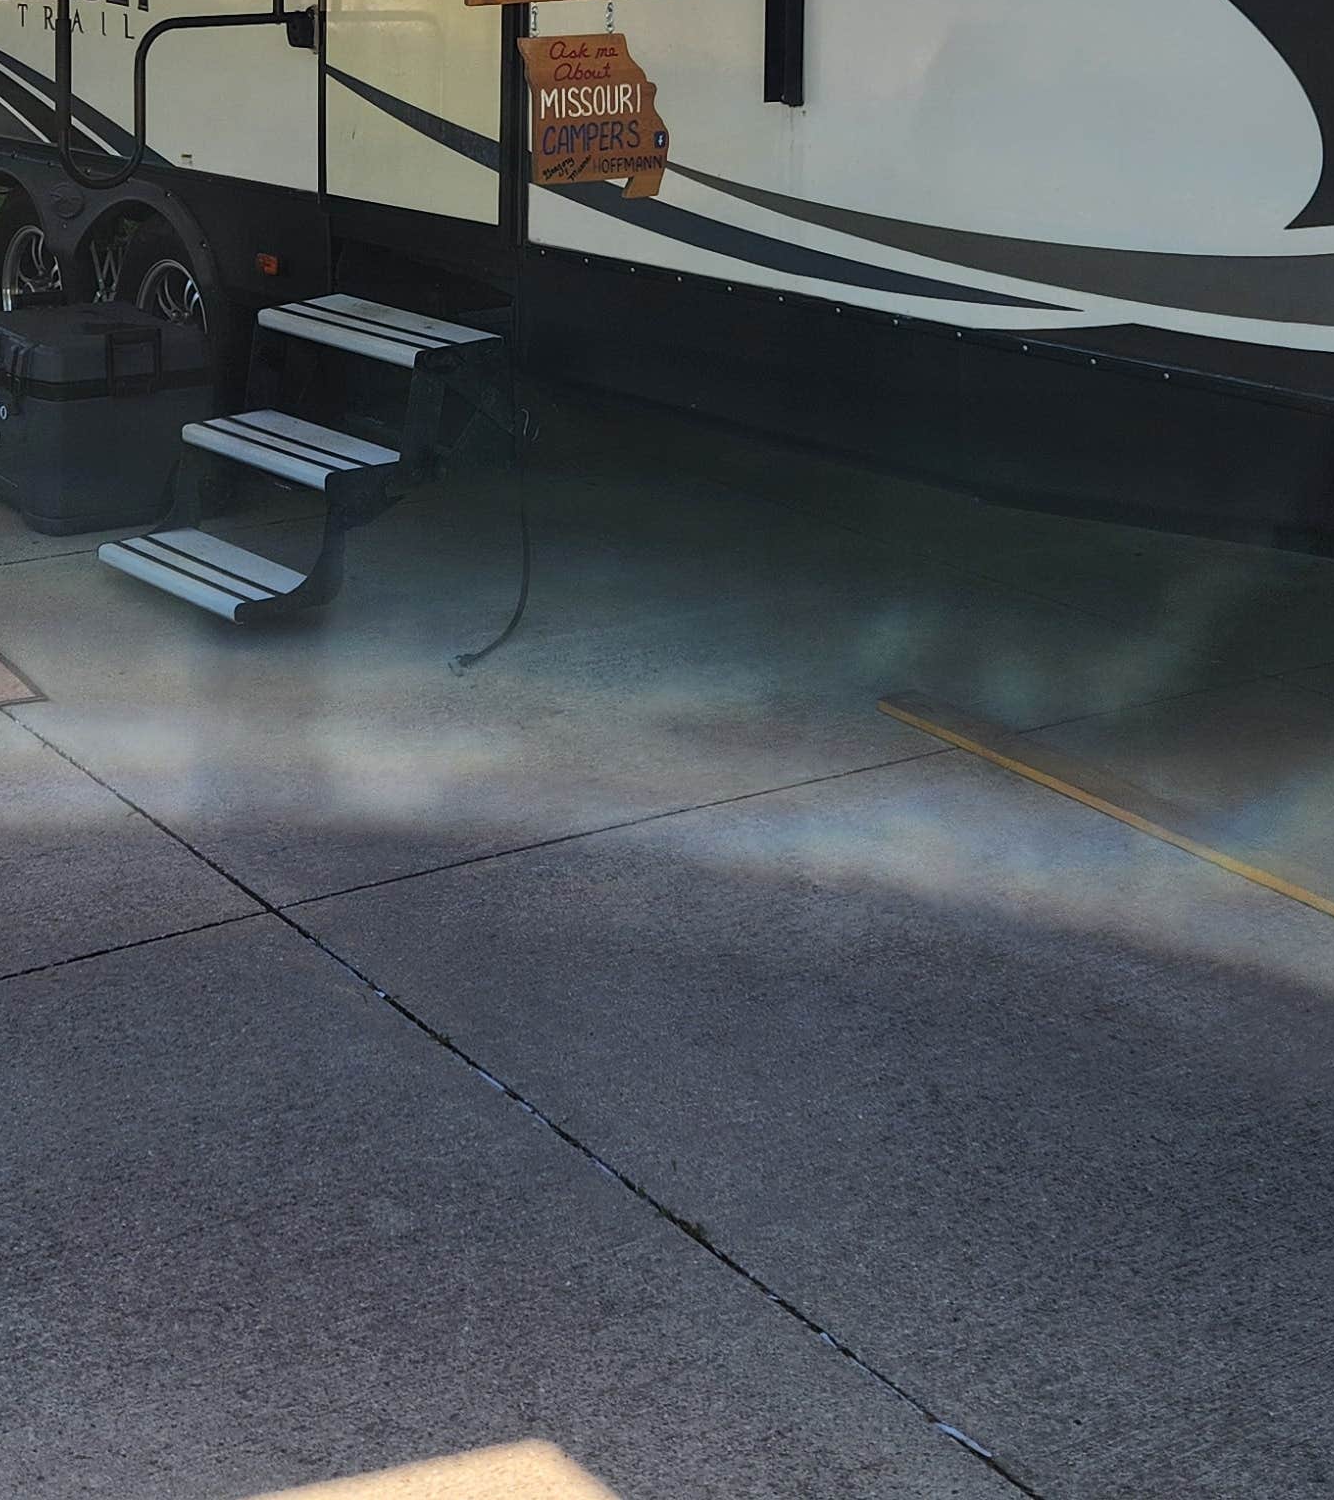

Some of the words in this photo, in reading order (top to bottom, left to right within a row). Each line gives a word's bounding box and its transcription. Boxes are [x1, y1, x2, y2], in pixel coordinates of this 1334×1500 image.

[18, 3, 135, 39] TRAIL
[549, 41, 590, 60] Ask
[595, 46, 619, 60] me
[554, 62, 612, 81] About
[540, 83, 642, 120] MISSOURI
[542, 119, 641, 156] CAMPERS
[592, 154, 663, 174] HOFFMANN
